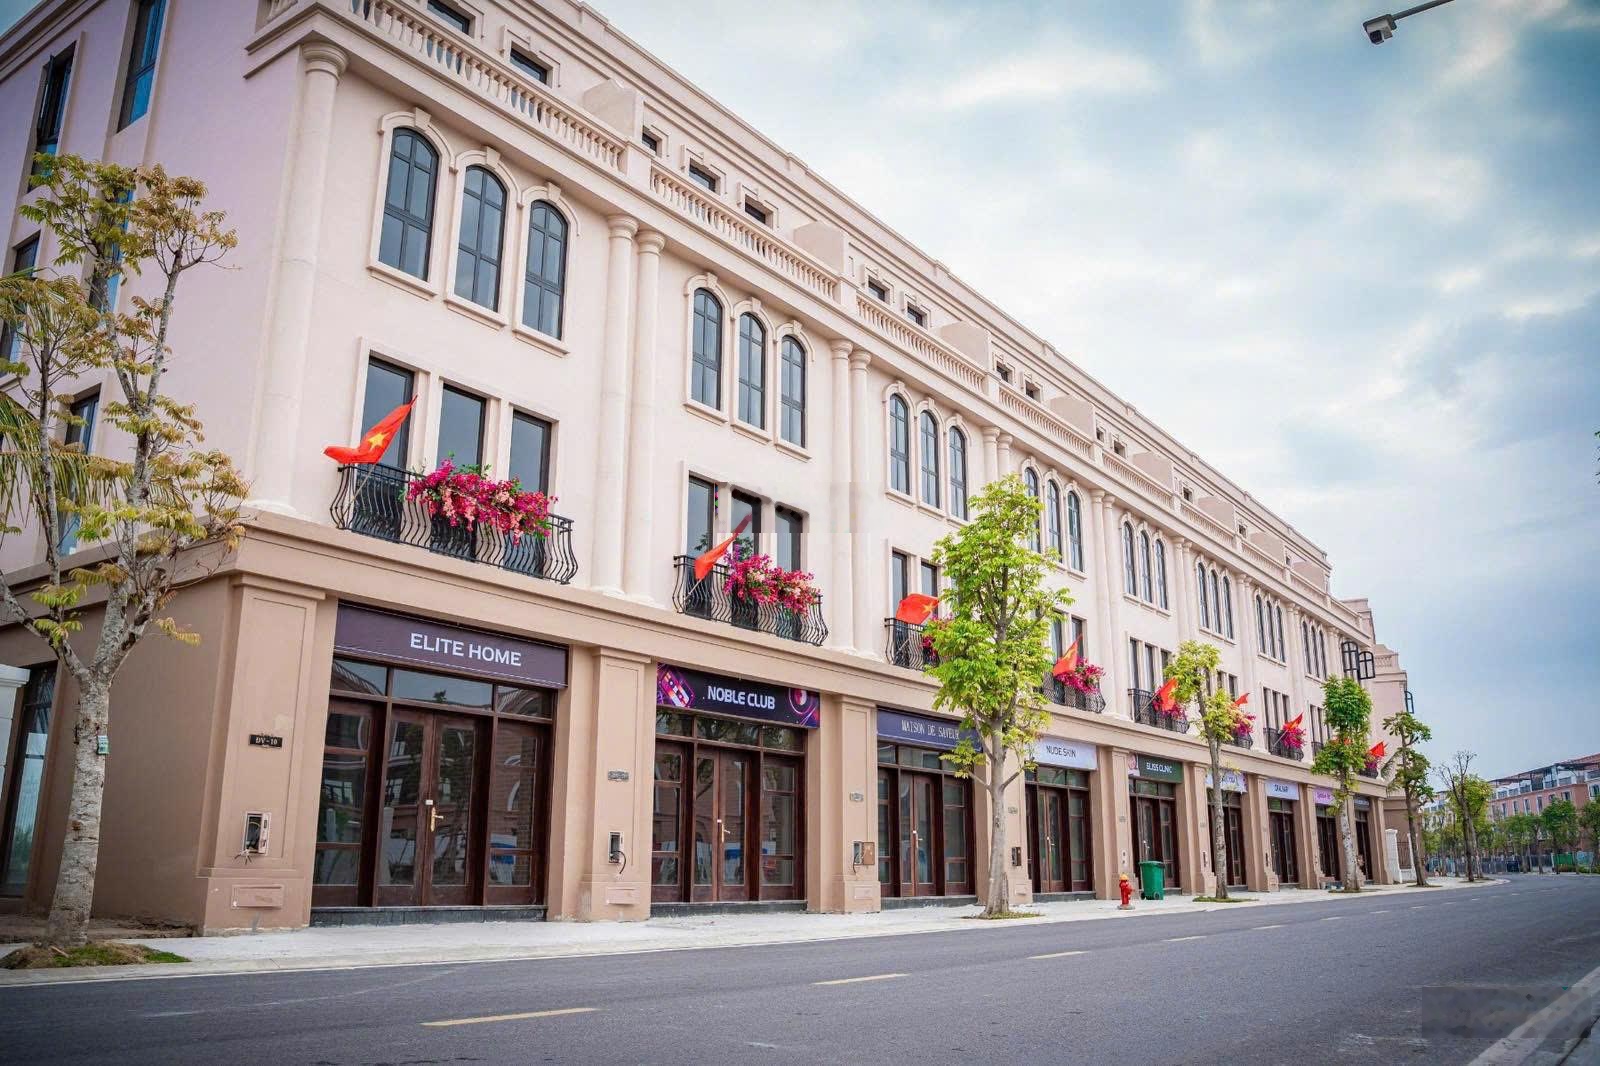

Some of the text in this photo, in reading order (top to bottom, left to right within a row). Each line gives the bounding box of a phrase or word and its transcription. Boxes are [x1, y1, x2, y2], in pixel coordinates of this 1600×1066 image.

[410, 632, 521, 666] ELITE HOME
[707, 685, 775, 710] NOBLE CLUB
[901, 719, 925, 735] MAISON
[927, 724, 936, 737] DE
[1046, 744, 1077, 758] NUDE SKIN
